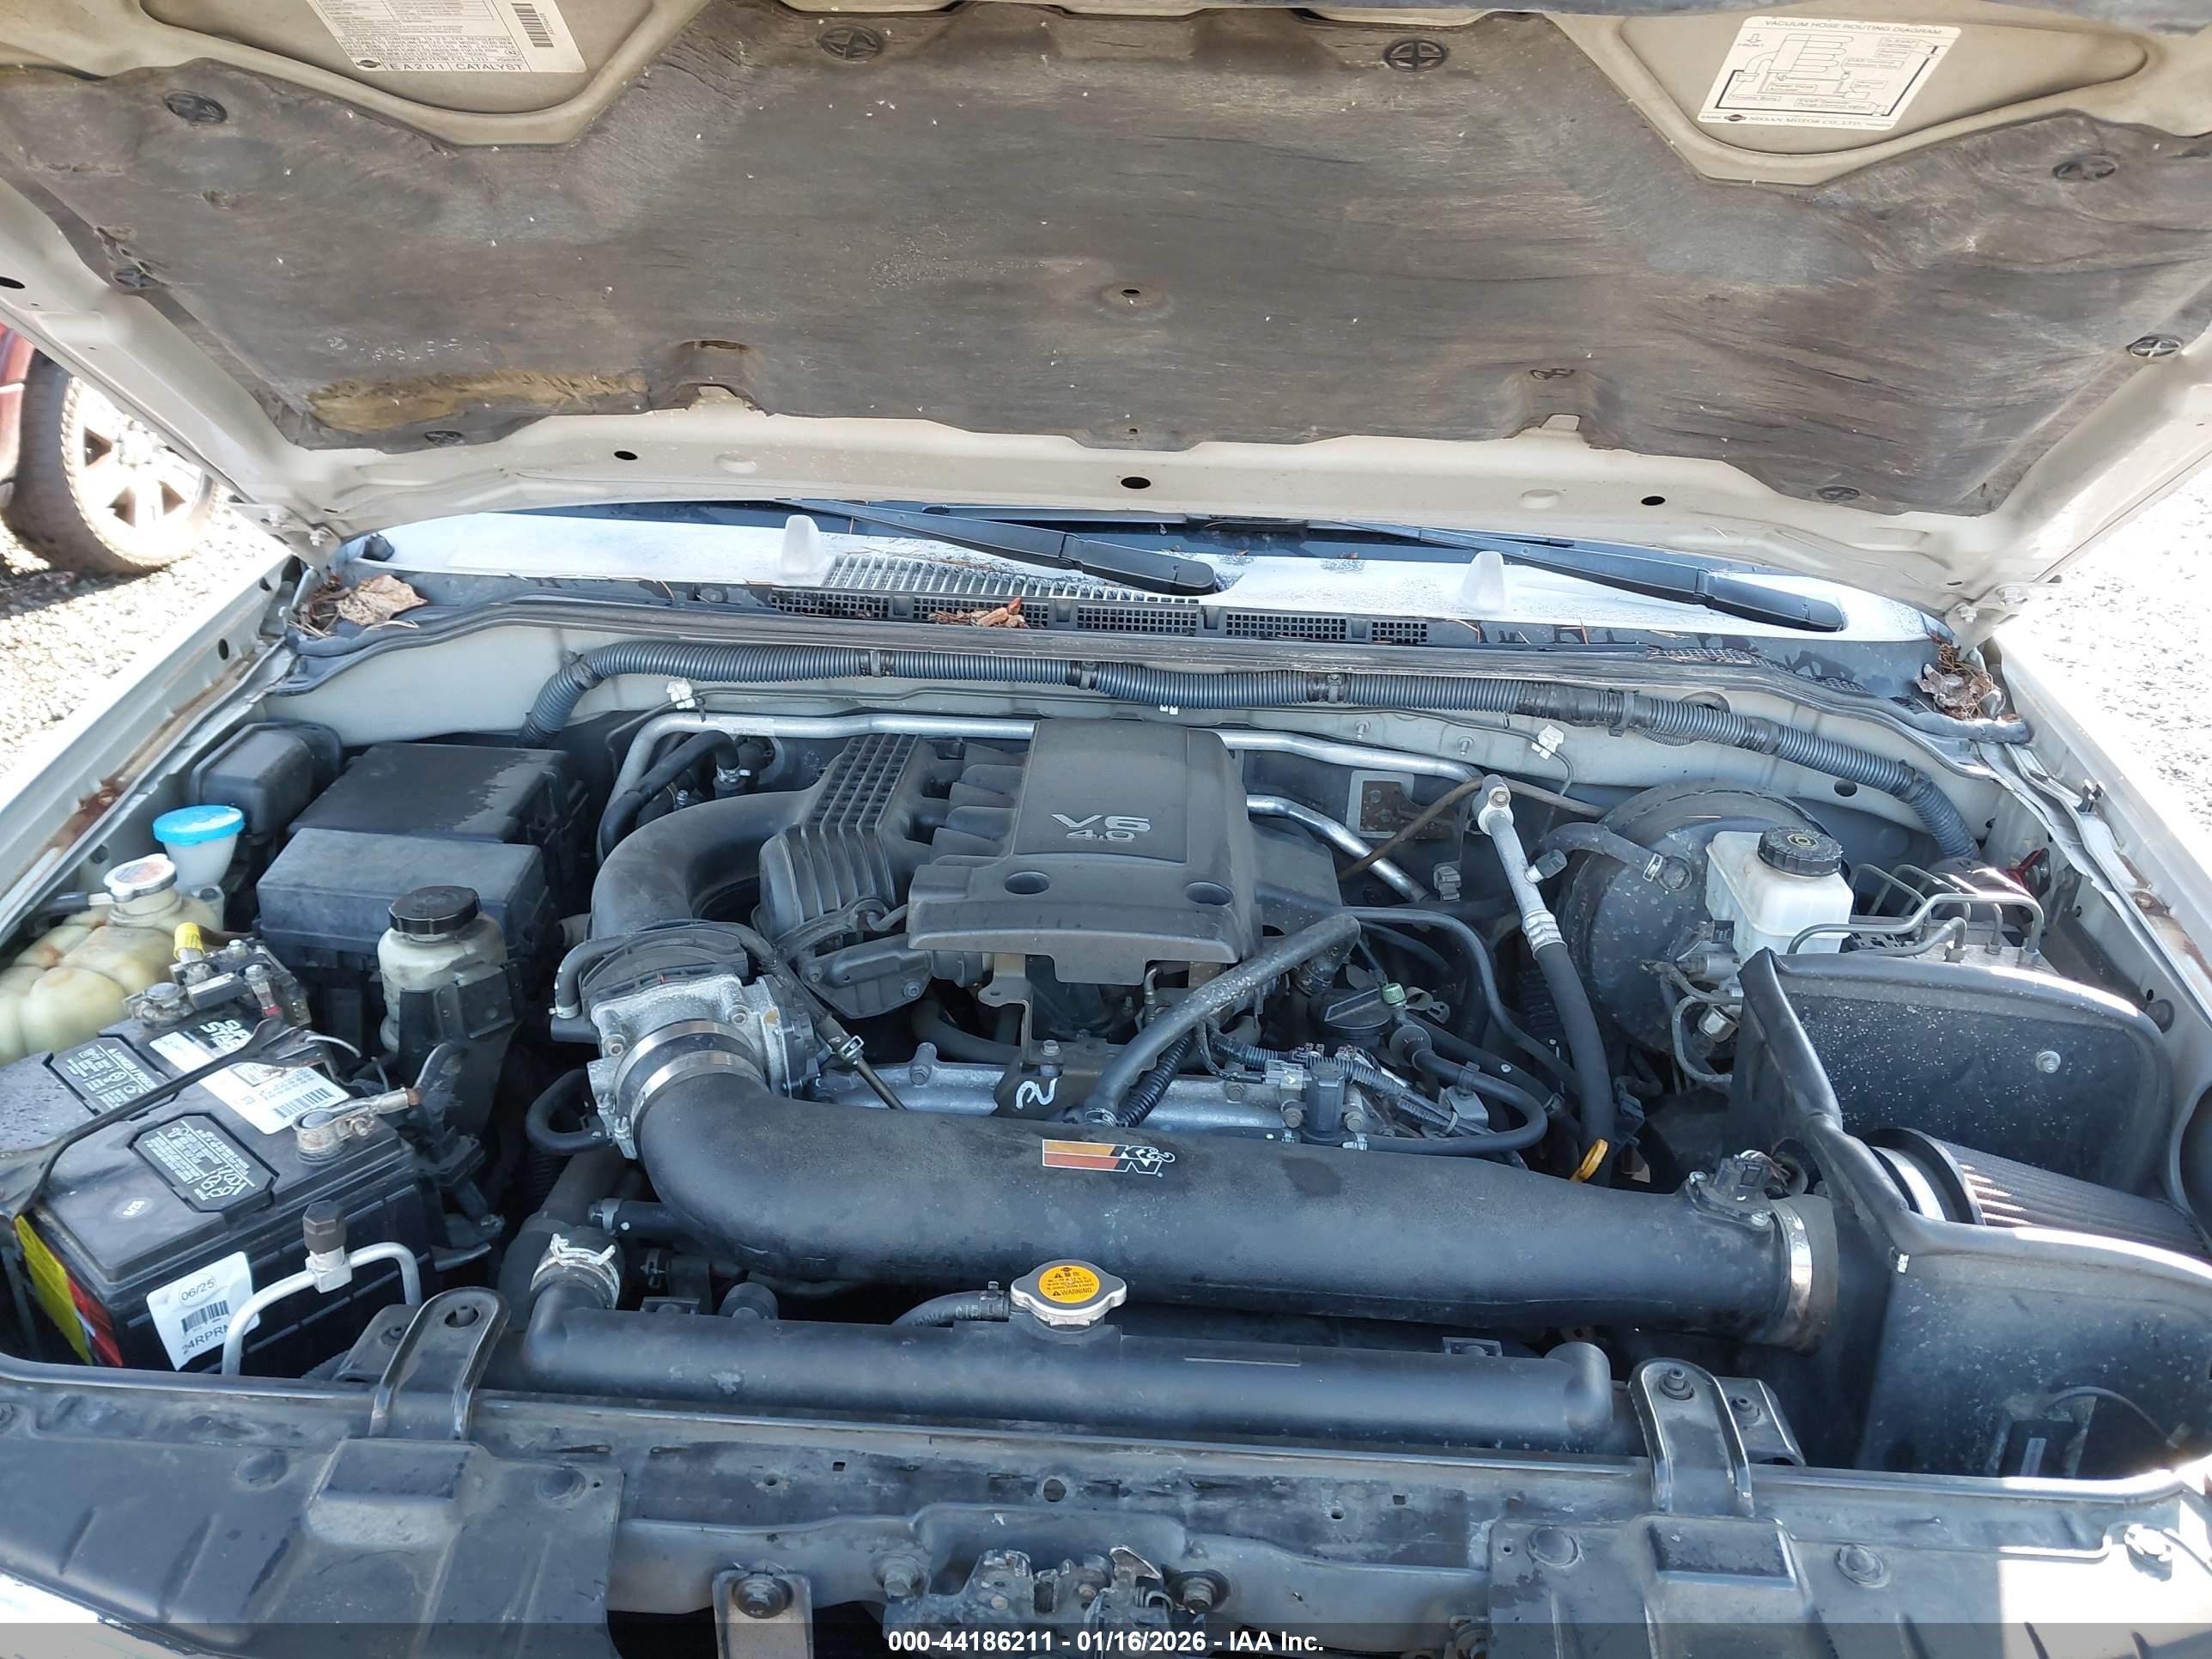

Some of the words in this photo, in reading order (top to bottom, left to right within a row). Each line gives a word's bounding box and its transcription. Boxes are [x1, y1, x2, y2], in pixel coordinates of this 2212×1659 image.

[1843, 23, 1890, 32] ROUTING
[1051, 813, 1151, 831] V6
[1066, 829, 1135, 842] 4.0
[180, 1279, 216, 1301] 06/25
[1060, 1286, 1093, 1296] WARNING
